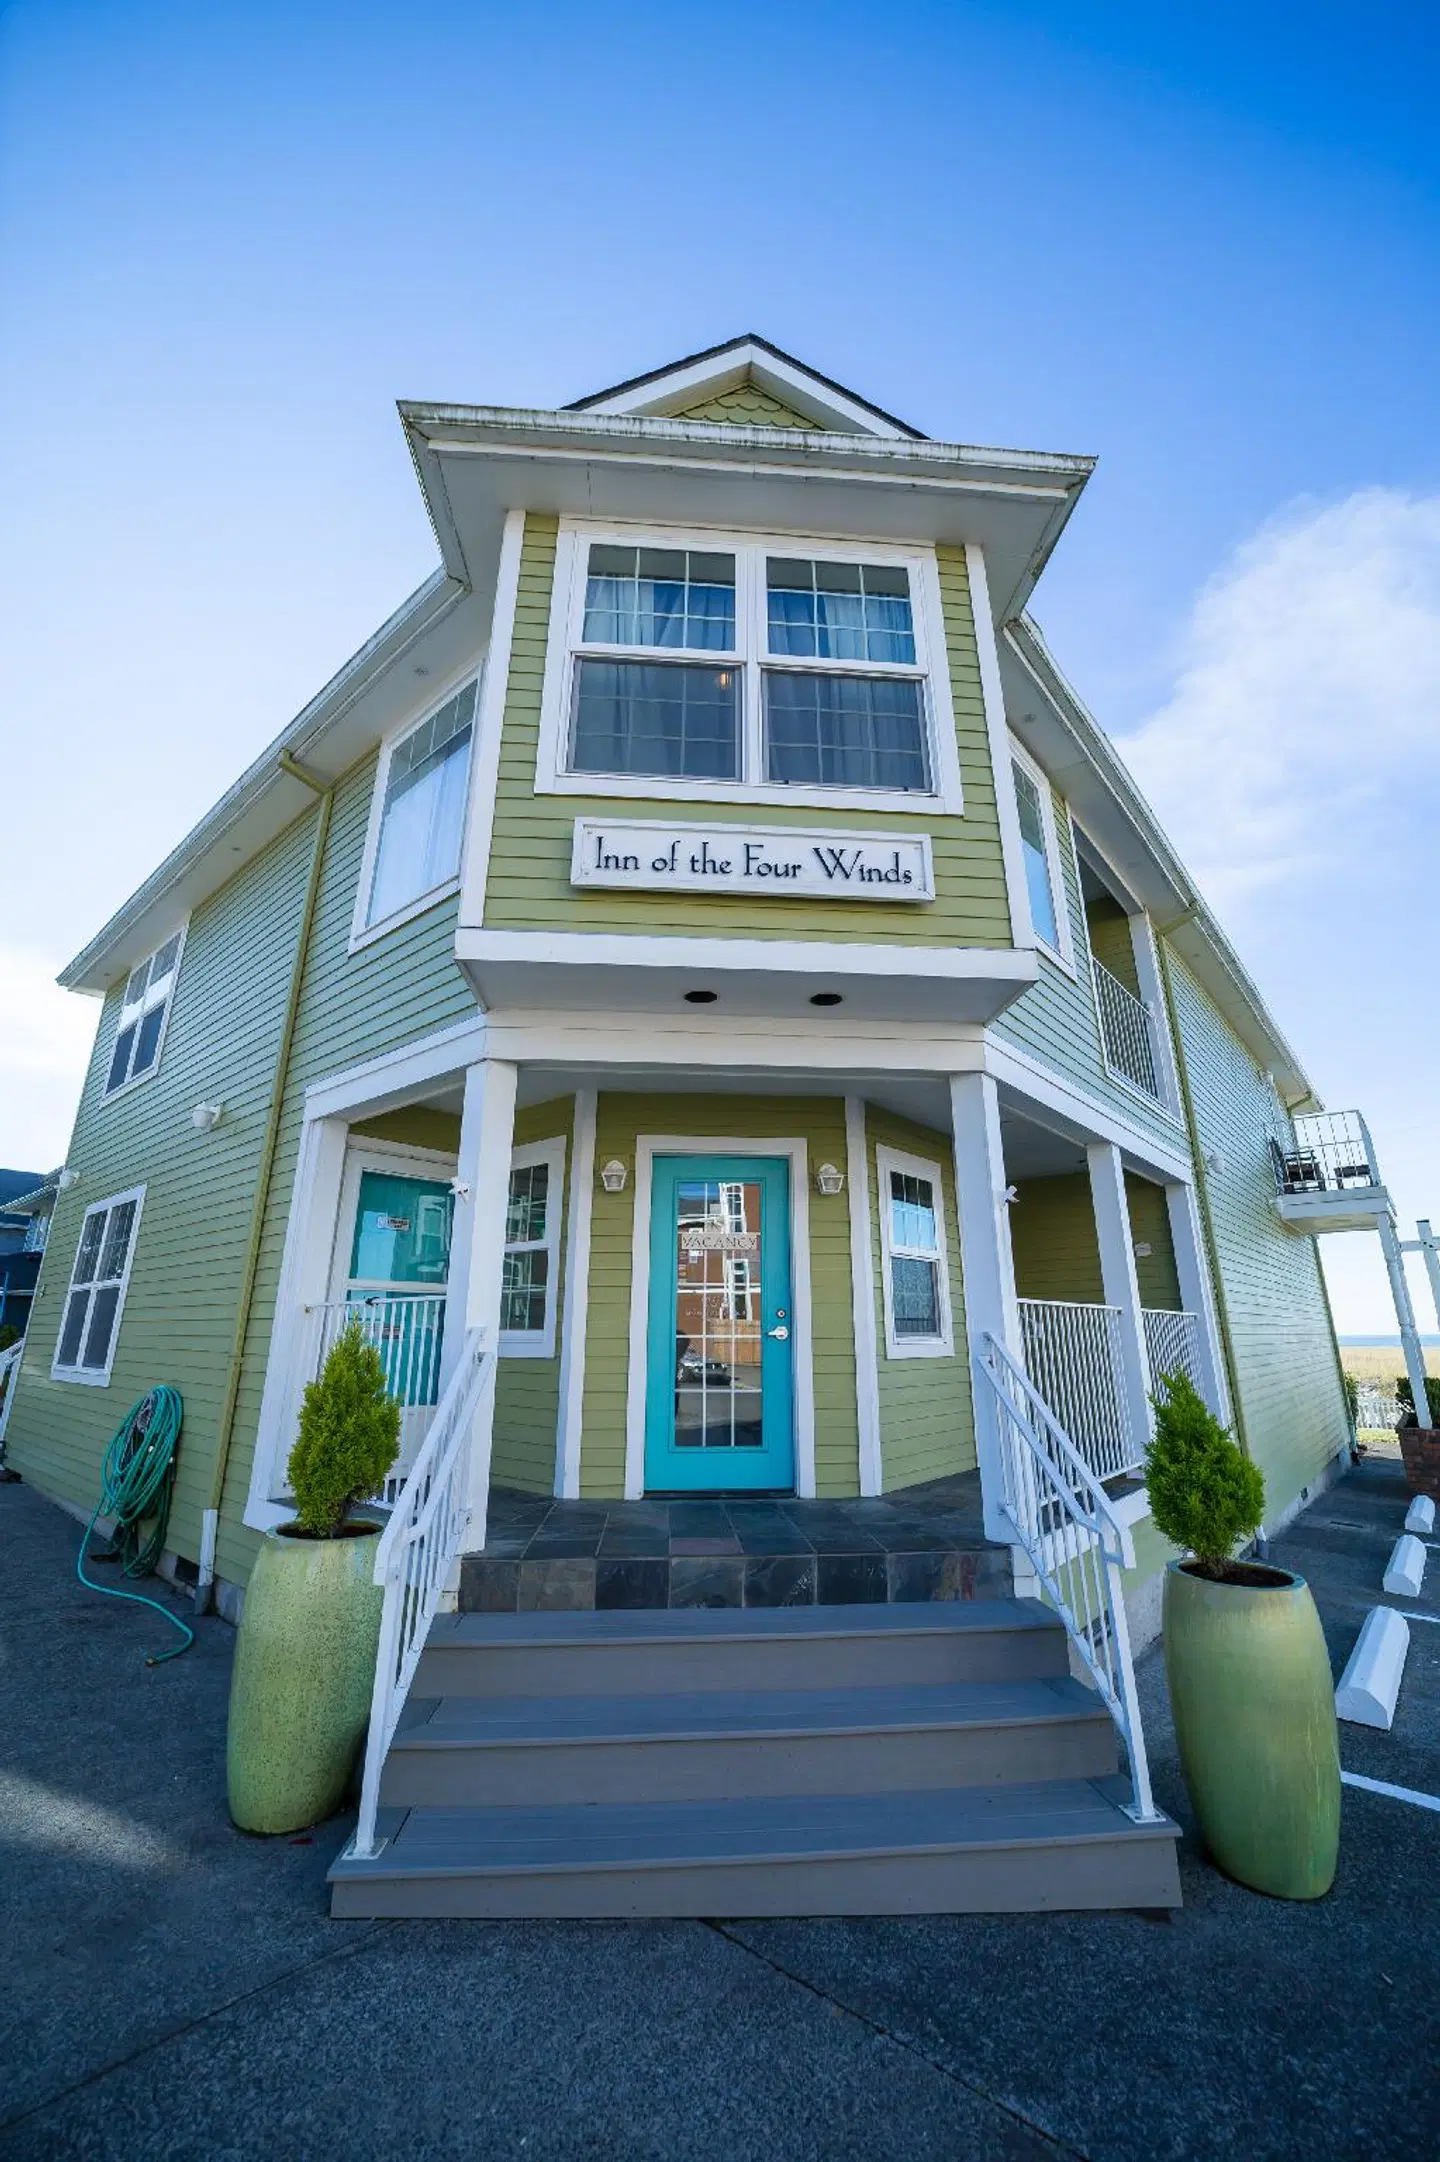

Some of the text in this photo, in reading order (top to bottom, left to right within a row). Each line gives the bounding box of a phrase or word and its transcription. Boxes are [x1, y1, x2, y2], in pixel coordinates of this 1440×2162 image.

[595, 836, 913, 884] Inn of the Four Winds
[682, 1237, 756, 1249] VACANCY
